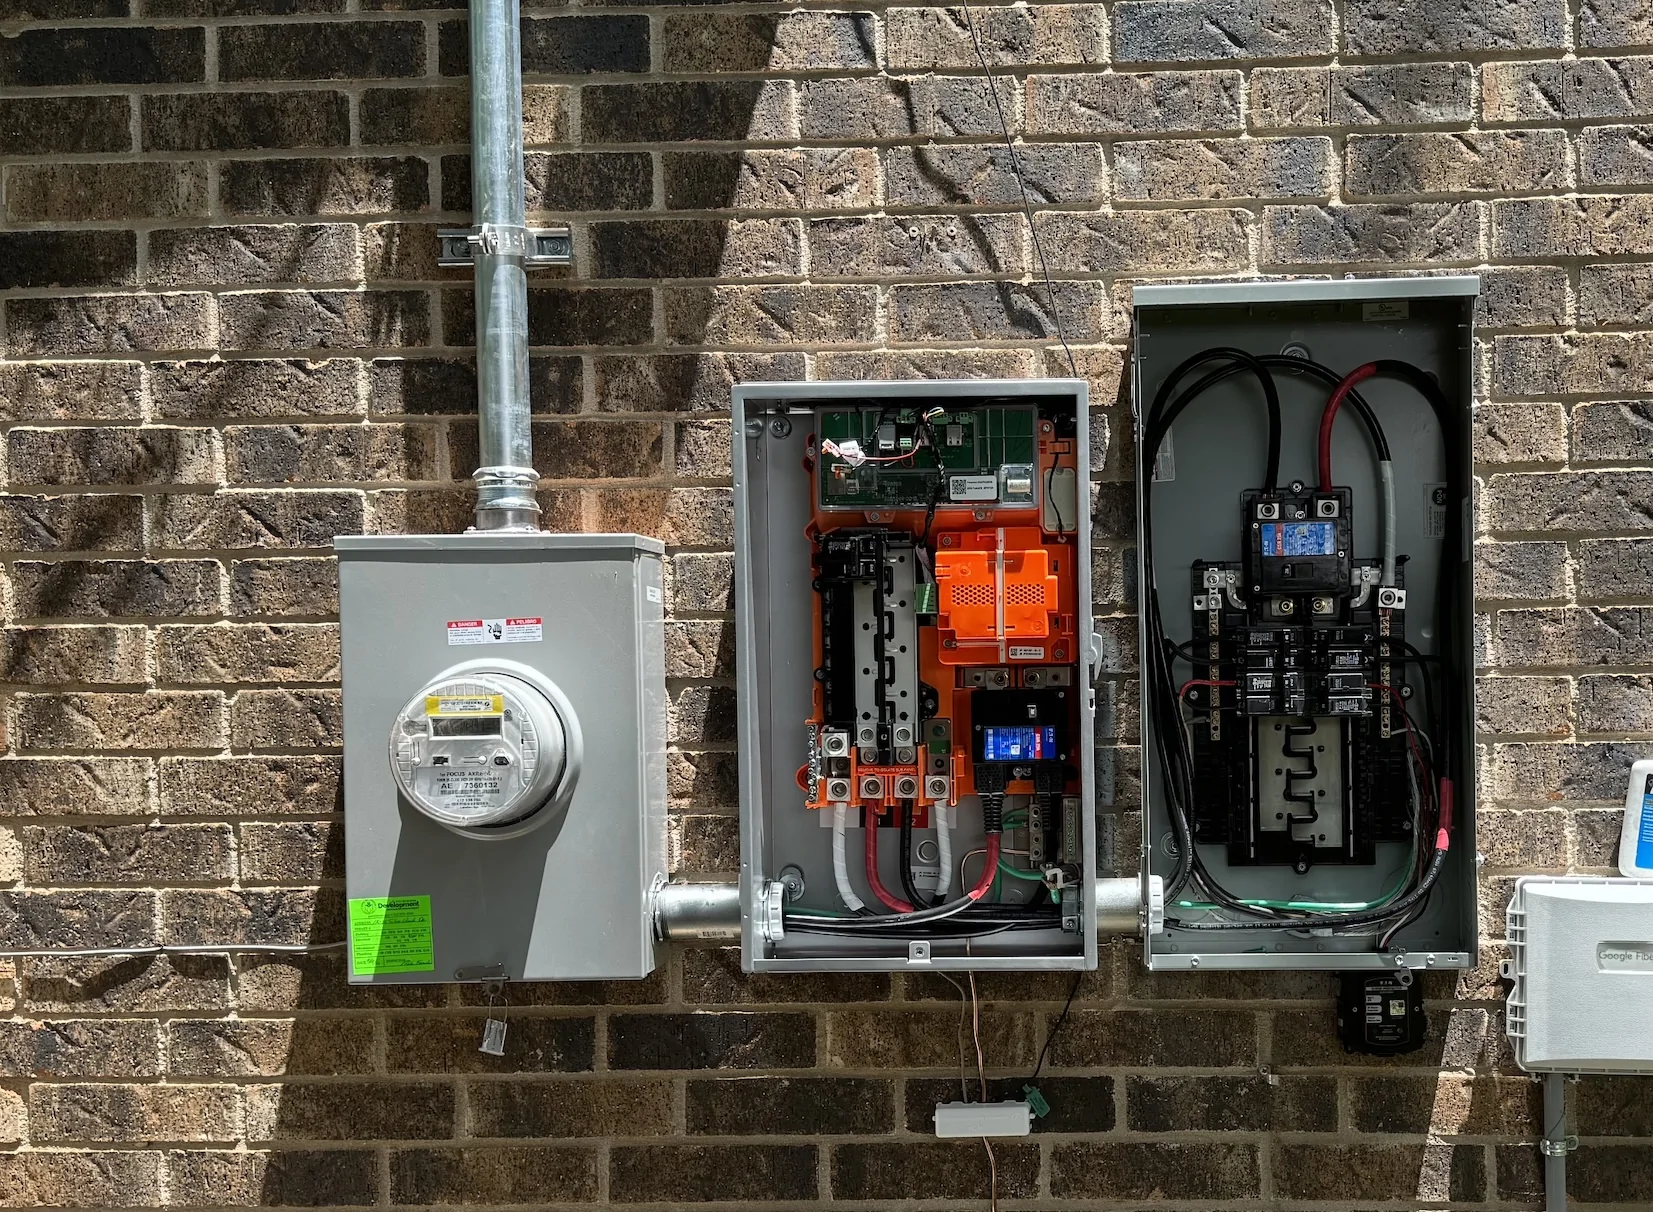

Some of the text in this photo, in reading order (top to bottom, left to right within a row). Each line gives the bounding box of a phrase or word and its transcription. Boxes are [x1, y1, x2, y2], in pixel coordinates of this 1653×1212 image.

[464, 781, 498, 789] 7360132
[377, 900, 420, 909] Development
[1598, 950, 1653, 962] Google Fibe
